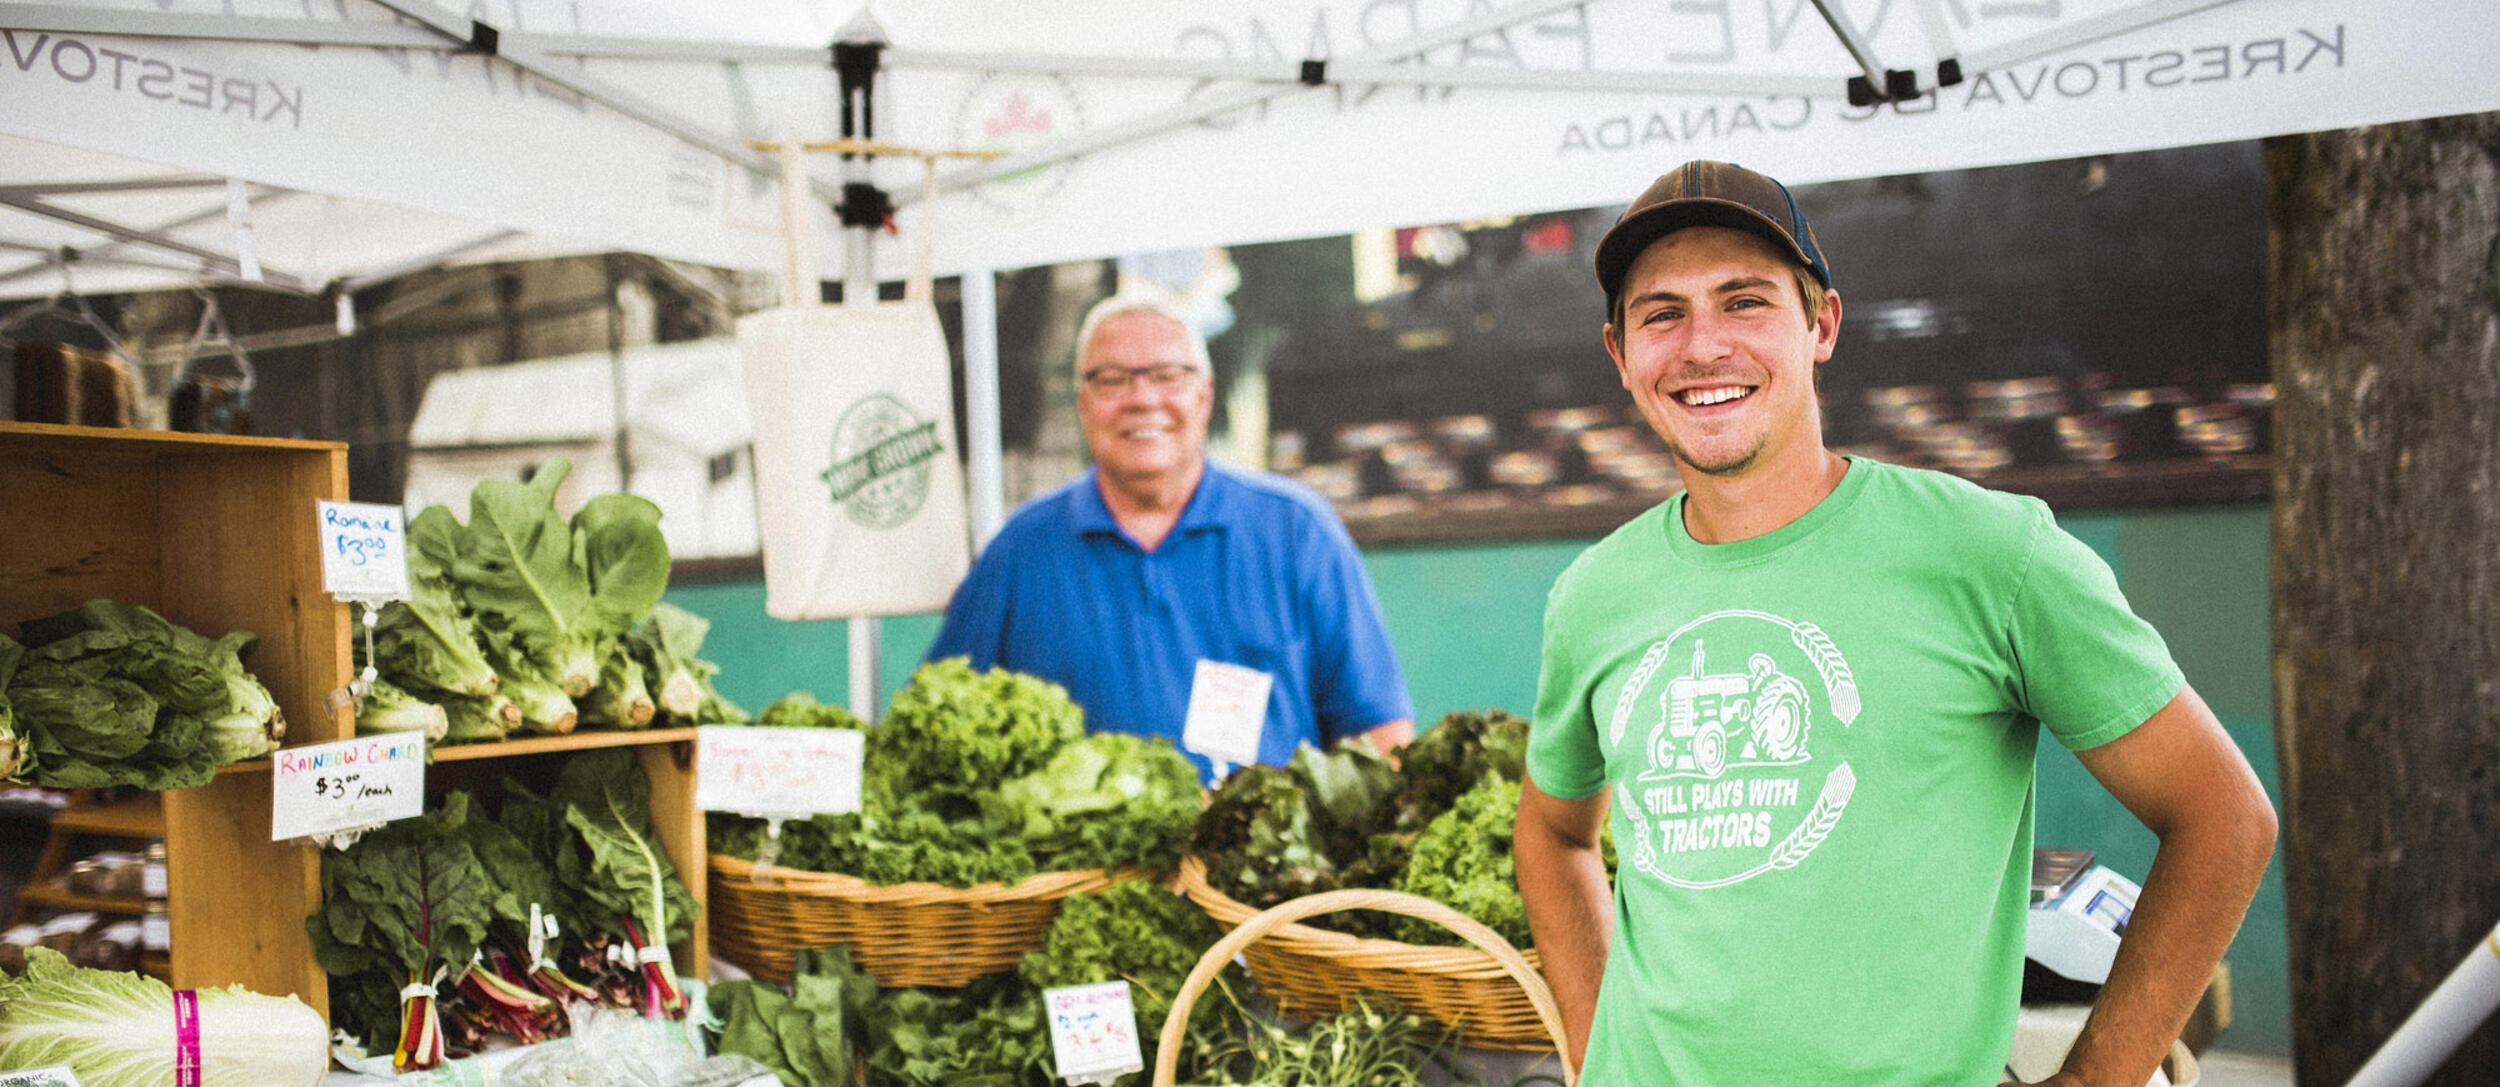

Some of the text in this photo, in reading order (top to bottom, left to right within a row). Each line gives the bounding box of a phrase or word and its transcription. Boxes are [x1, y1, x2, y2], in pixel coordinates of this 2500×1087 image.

[280, 743, 418, 776] RAINBOW CHARD
[1643, 778, 1799, 815] STILL PLAYS WITH
[1658, 811, 1772, 854] TRACTORS
